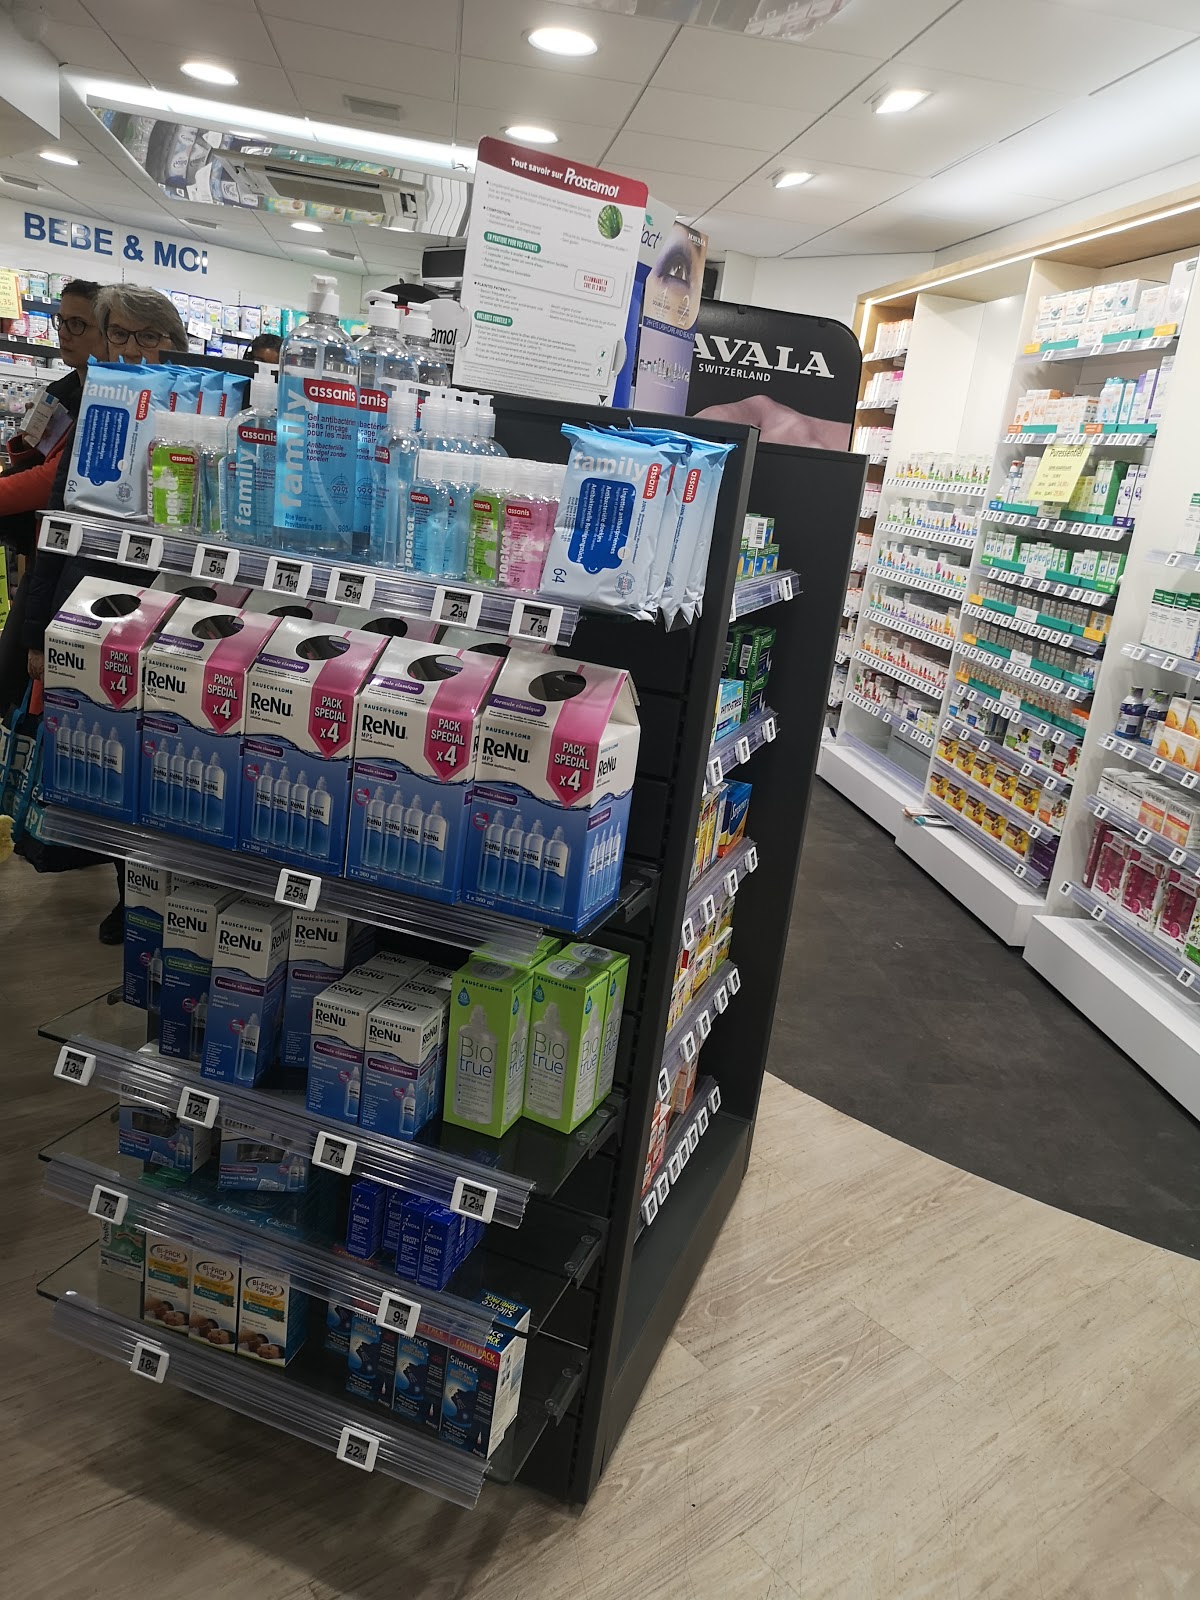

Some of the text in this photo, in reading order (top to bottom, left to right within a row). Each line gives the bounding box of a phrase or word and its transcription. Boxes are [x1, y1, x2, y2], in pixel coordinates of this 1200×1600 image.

[511, 158, 619, 198] Tout savoir sur Prostamol
[25, 212, 207, 274] BEBE & MOI
[693, 332, 835, 379] AVALA
[698, 363, 771, 382] SWITZERLAND
[83, 380, 139, 406] family
[309, 385, 356, 402] assanis
[138, 392, 148, 419] assanis
[307, 413, 320, 422] Gel
[242, 430, 276, 442] assanis
[306, 429, 321, 437] pour
[322, 430, 333, 438] les
[326, 423, 348, 433] rinçage
[281, 389, 313, 508] family
[306, 449, 328, 458] handgel
[306, 454, 329, 463] spoelen
[171, 455, 194, 463] assanis
[573, 452, 648, 481] family
[67, 479, 76, 493] 64
[234, 448, 257, 526] family
[646, 465, 659, 497] assanis
[685, 471, 698, 501] assanis
[410, 494, 429, 503] assanis
[474, 502, 490, 511] assanis
[586, 483, 596, 521] Antibakterielle
[618, 488, 628, 510] Lingettes
[295, 514, 307, 522] Vera
[508, 508, 530, 517] assanis
[285, 520, 314, 530] Provitamine
[595, 521, 607, 542] doekjes
[405, 516, 415, 568] pocket
[551, 568, 567, 584] 64
[48, 648, 85, 671] ReNu
[110, 650, 128, 663] PACK
[104, 661, 133, 675] SPECIAL
[110, 676, 127, 695] x4
[148, 670, 186, 694] ReNu
[214, 673, 234, 687] PACK
[207, 685, 238, 700] SPECIAL
[213, 699, 231, 719] x4
[251, 692, 292, 717] ReNu
[322, 696, 343, 710] PACK
[493, 697, 541, 713] formule classique
[314, 707, 346, 723] SPECIAL
[320, 723, 339, 743] x4
[362, 714, 406, 740] ReNu
[439, 718, 460, 733] PACK
[431, 730, 465, 746] SPECIAL
[436, 746, 457, 767] x4
[483, 737, 529, 763] ReNu
[562, 742, 585, 757] PACK
[554, 753, 590, 770] SPECIAL
[597, 755, 617, 777] ReNu
[559, 769, 581, 791] x4
[127, 869, 159, 891] ReNu
[167, 911, 207, 934] ReNu
[219, 930, 262, 953] ReNu
[295, 924, 338, 943] ReNu
[315, 1008, 346, 1027] ReNu
[369, 1025, 401, 1043] ReNu
[422, 1025, 438, 1046] ReNu
[461, 1036, 493, 1062] Bio
[534, 1031, 565, 1059] Bio
[459, 1056, 492, 1079] true
[533, 1052, 563, 1075] true
[252, 1279, 278, 1292] BI-PACK
[450, 1354, 477, 1374] Silence
